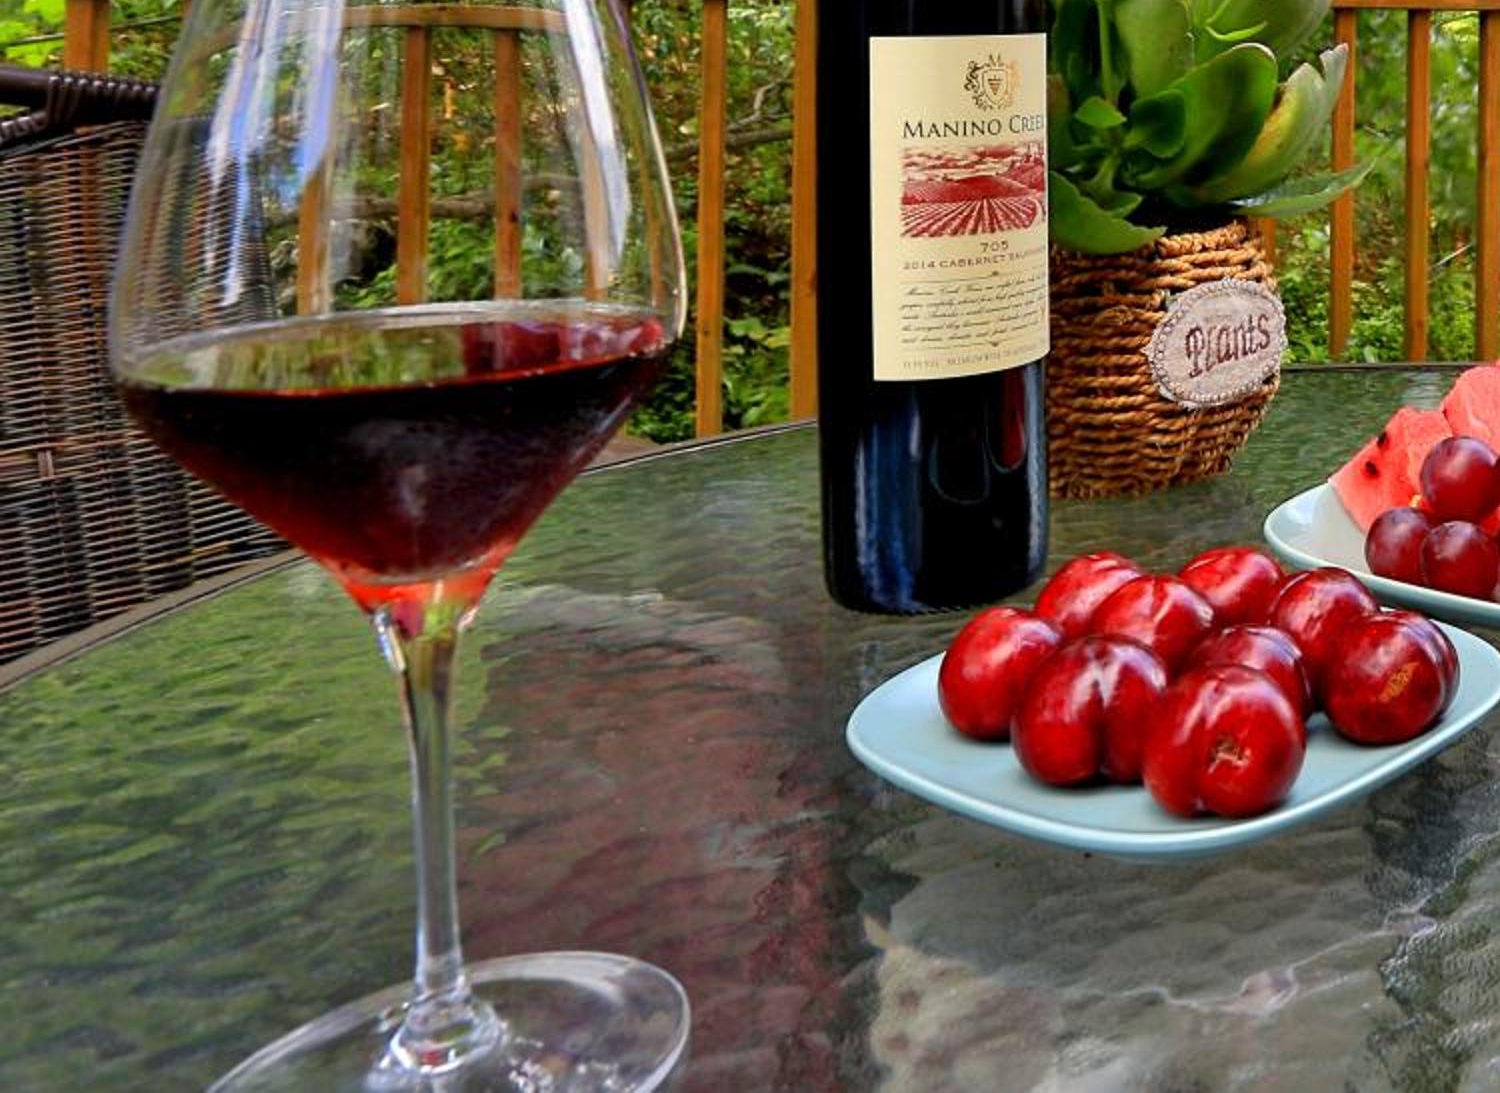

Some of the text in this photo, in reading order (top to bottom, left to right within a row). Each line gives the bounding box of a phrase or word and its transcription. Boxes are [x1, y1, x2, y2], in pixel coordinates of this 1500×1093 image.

[903, 118, 1002, 139] MANINO
[979, 240, 1009, 253] 705
[939, 254, 1006, 269] CABERNET
